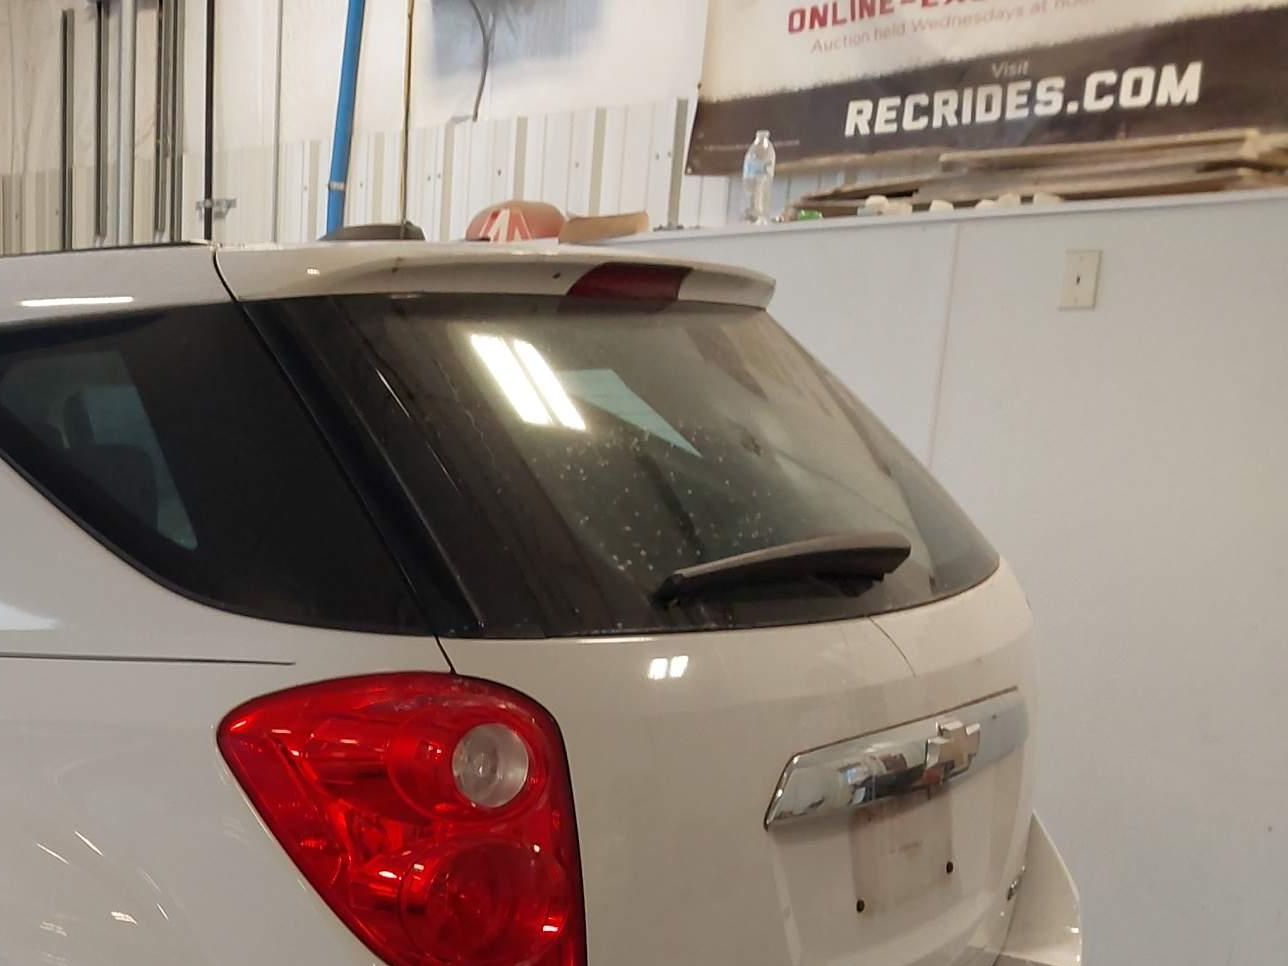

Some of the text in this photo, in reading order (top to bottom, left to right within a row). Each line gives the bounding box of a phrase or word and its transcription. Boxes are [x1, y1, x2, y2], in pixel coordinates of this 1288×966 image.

[810, 31, 871, 54] Auction
[991, 60, 1030, 79] Visit
[844, 61, 1203, 137] RECRIDES.COM
